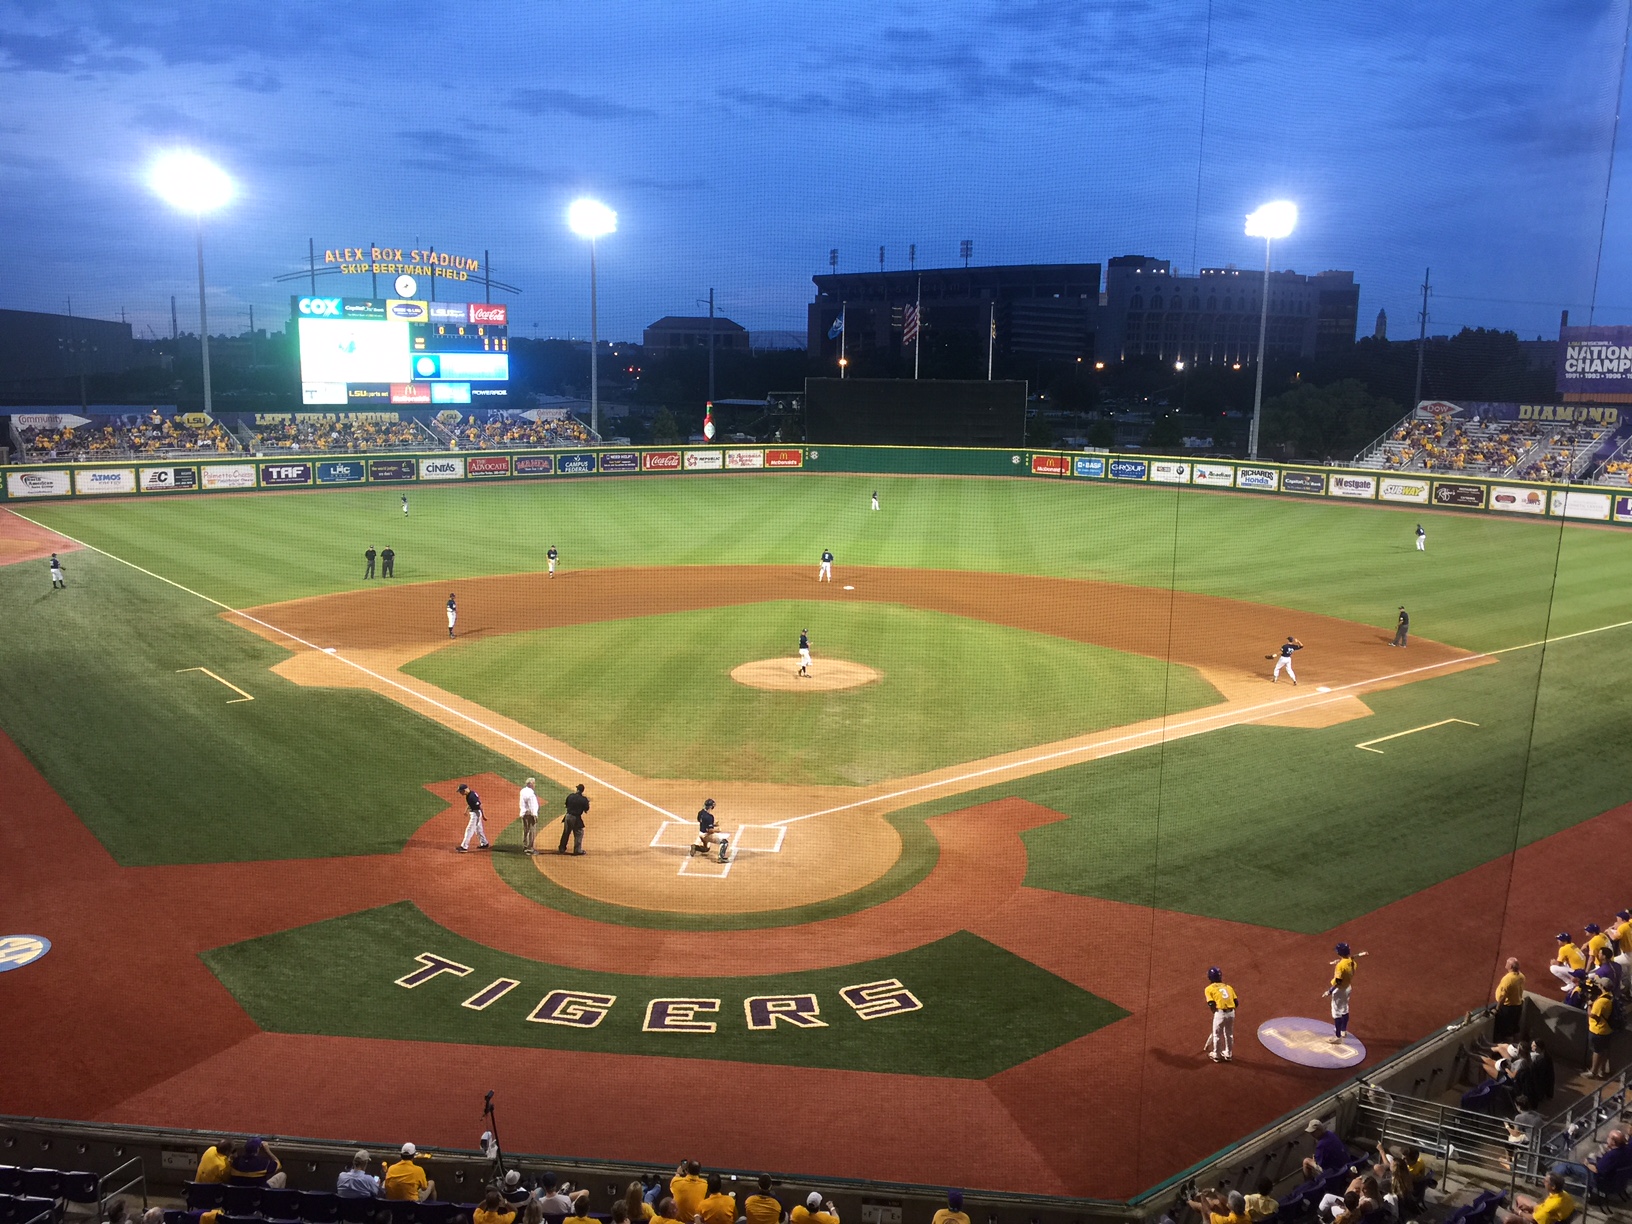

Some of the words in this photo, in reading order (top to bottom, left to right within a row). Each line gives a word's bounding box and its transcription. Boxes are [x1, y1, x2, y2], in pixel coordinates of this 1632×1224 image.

[325, 248, 364, 264] ALEX
[371, 247, 403, 262] BOX
[411, 250, 479, 272] STADIUM
[340, 263, 369, 275] SKIP
[372, 263, 432, 276] BERTMAN
[435, 267, 468, 282] FIELD
[298, 298, 340, 317] COX
[439, 326, 445, 335] 0
[18, 415, 63, 425] Community
[255, 413, 292, 425] LEFT
[295, 413, 337, 424] FIELD
[339, 412, 400, 423] LANDING
[1518, 405, 1618, 423] DIAMOND
[470, 462, 508, 471] ADVOCATE
[651, 455, 679, 467] Coca-Cola
[1085, 461, 1102, 469] BASF
[203, 471, 232, 479] Palmetto
[232, 470, 253, 478] Cheese
[268, 466, 304, 479] TAF
[330, 465, 350, 474] LHC
[1240, 469, 1274, 481] RICHARDS
[90, 473, 121, 482] ATMOS
[1244, 477, 1269, 485] Honda
[1334, 477, 1371, 489] Westgate
[1383, 485, 1425, 497] SUBWAY
[394, 952, 924, 1033] TIGERS
[1218, 988, 1229, 999] 3
